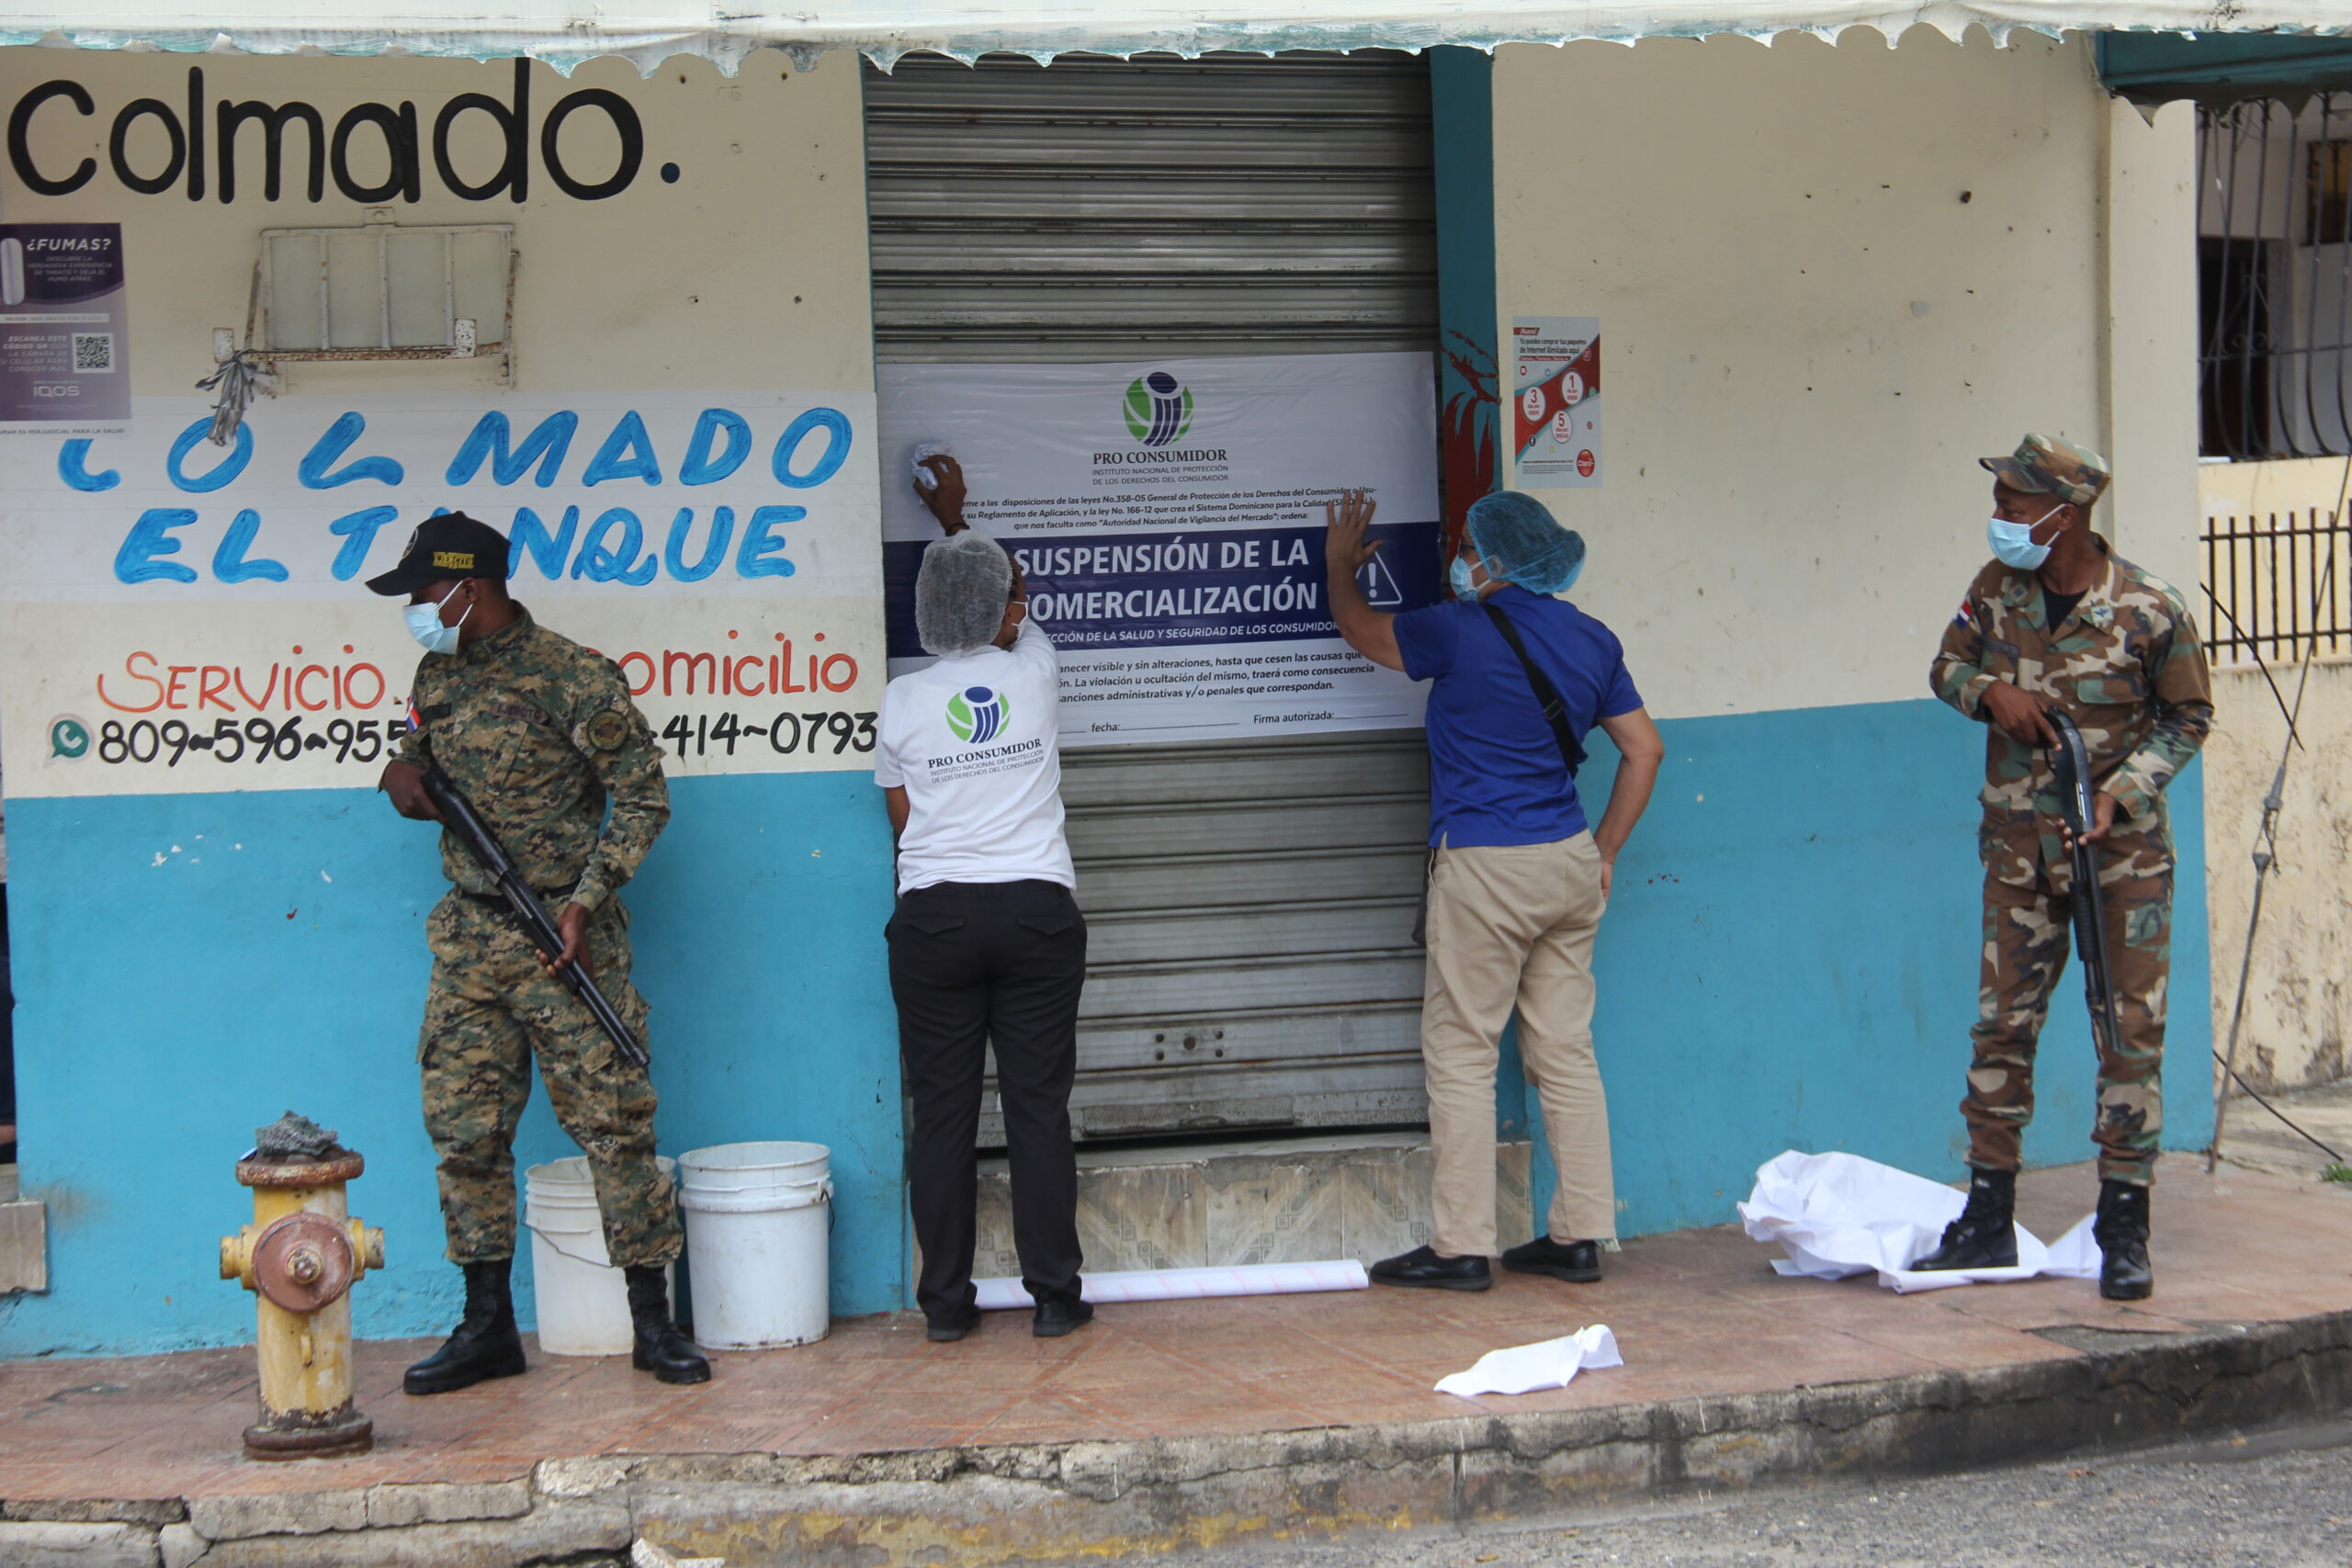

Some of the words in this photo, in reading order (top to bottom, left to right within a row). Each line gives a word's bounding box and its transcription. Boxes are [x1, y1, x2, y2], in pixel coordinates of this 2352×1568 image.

[27, 238, 112, 251] ¿FUMAS?
[1569, 375, 1574, 389] 1
[33, 386, 80, 399] IQOS
[1531, 389, 1537, 403] 3
[1558, 413, 1565, 427] 5
[1092, 452, 1123, 465] PRO
[1126, 449, 1227, 463] CONSUMIDOR
[1092, 468, 1130, 476] INSTITUTO
[1132, 467, 1170, 475] NACIONAL
[1182, 464, 1228, 473] PROTECCIÓN
[1121, 476, 1160, 484] DERECHOS
[1178, 474, 1229, 482] CONSUMIDOR
[987, 499, 999, 507] las
[1001, 497, 1055, 507] disposiciones
[1057, 496, 1067, 504] de
[1068, 496, 1080, 504] las
[1080, 496, 1101, 506] leyes
[1102, 494, 1146, 503] No.358-05
[1148, 493, 1177, 502] General
[1179, 492, 1188, 501] de
[1190, 491, 1230, 501] Protección
[1256, 490, 1291, 498] Derechos
[1306, 487, 1351, 496] Consumidor
[978, 511, 1026, 520] Reglamento
[1039, 508, 1081, 518] Aplicación,
[1089, 507, 1097, 515] la
[1098, 507, 1109, 516] ley
[1112, 506, 1125, 514] No.
[1126, 506, 1152, 514] 166-12
[1154, 507, 1169, 515] que
[1196, 503, 1227, 512] Sistema
[1228, 502, 1274, 511] Dominicano
[1275, 502, 1293, 511] para
[1013, 522, 1029, 530] que
[1046, 520, 1074, 529] faculta
[1075, 520, 1097, 528] como
[1143, 517, 1177, 525] Nacional
[1190, 514, 1227, 525] Vigilancia
[1227, 513, 1239, 522] del
[1281, 513, 1309, 521] ordena:
[113, 504, 289, 584] EL
[329, 504, 808, 586] TNQUE
[1013, 536, 1209, 577] SUSPENSIÓN
[1220, 540, 1260, 569] DE
[1271, 538, 1309, 567] LA
[1025, 576, 1317, 622] OMERCIALIZACIÓN
[1087, 631, 1101, 642] DE
[1103, 631, 1117, 641] LA
[1118, 629, 1155, 640] SALUD
[1157, 629, 1166, 638] Y
[1166, 626, 1227, 638] SEGURIDAD
[1229, 625, 1244, 636] DE
[1246, 624, 1267, 635] LOS
[1092, 660, 1125, 671] visible
[1126, 663, 1133, 672] y
[1135, 660, 1149, 670] sin
[1151, 659, 1214, 670] alteraciones,
[1216, 658, 1242, 667] hasta
[1244, 658, 1263, 667] que
[1264, 655, 1293, 664] cesen
[1295, 653, 1308, 662] las
[1310, 652, 1342, 661] causas
[1075, 678, 1087, 687] La
[1089, 676, 1132, 686] violación
[1144, 673, 1194, 684] ocultación
[1196, 672, 1211, 682] del
[1214, 671, 1250, 681] mismo,
[1252, 668, 1280, 678] traerá
[1283, 668, 1309, 677] como
[1311, 663, 1374, 676] consecuencia
[1106, 688, 1183, 700] administrativas
[1185, 685, 1204, 699] y/o
[1206, 685, 1244, 697] penales
[1246, 685, 1265, 695] que
[1266, 682, 1334, 694] correspondan.
[1091, 722, 1121, 733] fecha:
[1253, 714, 1280, 724] Firma
[1282, 711, 1335, 723] autorizada:
[927, 756, 954, 768] PRO
[956, 738, 1042, 763] CONSUMIDOR
[930, 766, 962, 777] INSTITUTO
[963, 760, 995, 772] NACIONAL
[1007, 748, 1044, 762] PROTECCIÓN
[955, 770, 988, 780] DERECHOS
[1002, 756, 1045, 772] CONSUMIDOR
